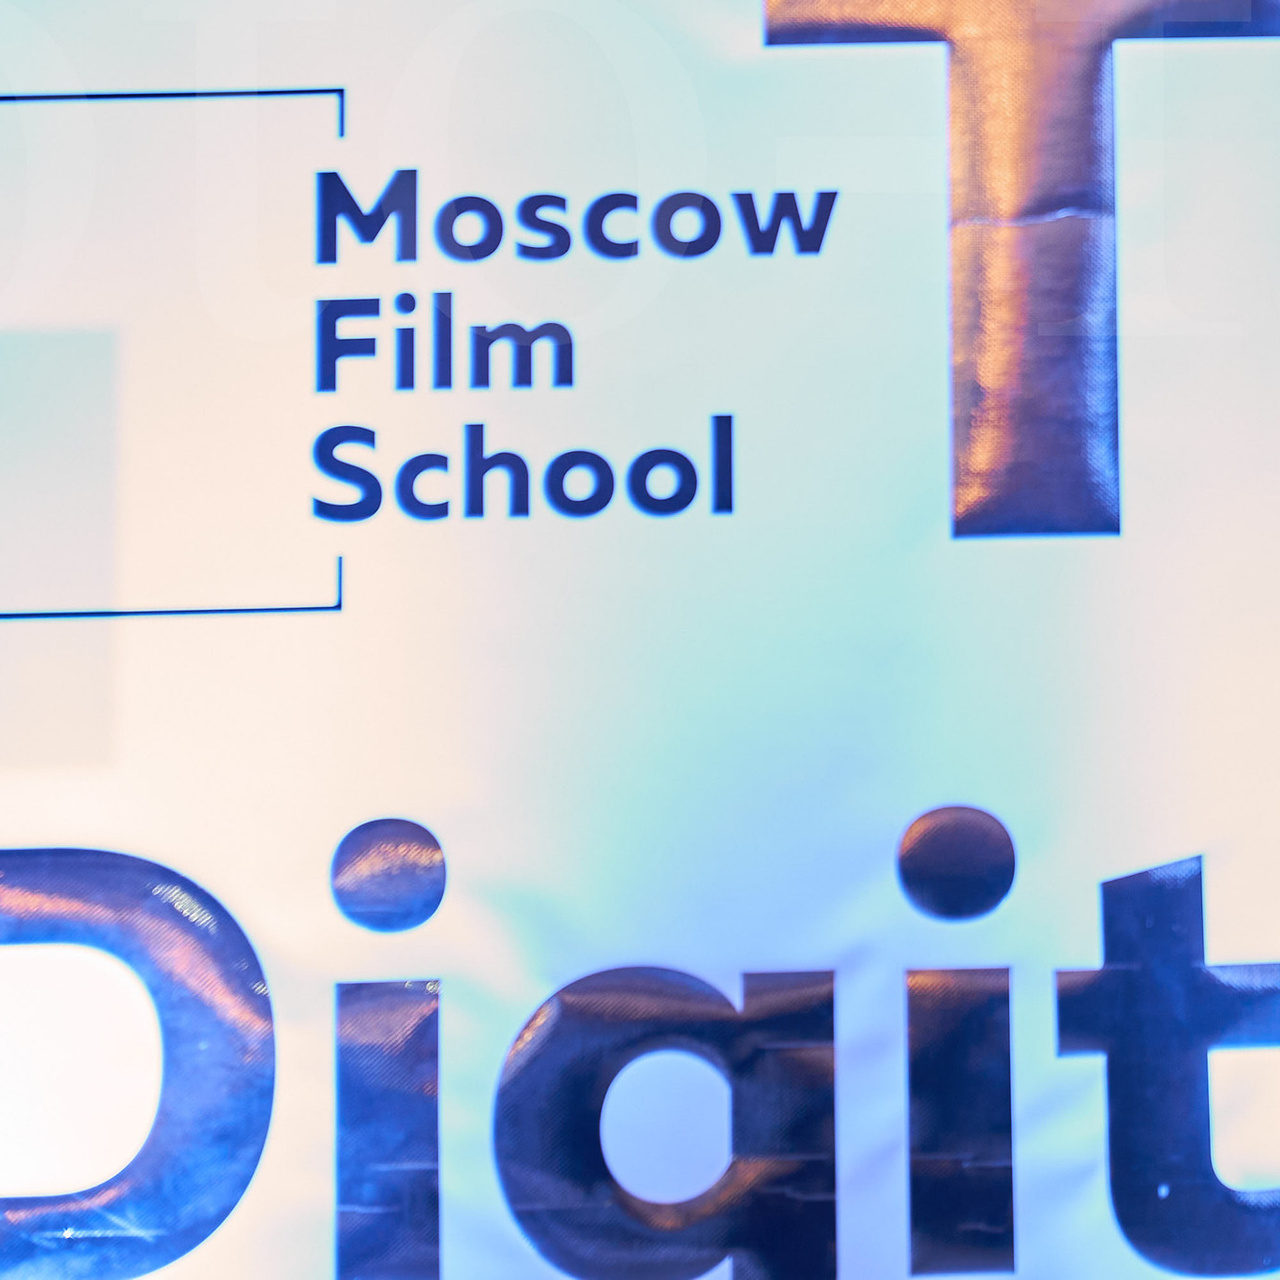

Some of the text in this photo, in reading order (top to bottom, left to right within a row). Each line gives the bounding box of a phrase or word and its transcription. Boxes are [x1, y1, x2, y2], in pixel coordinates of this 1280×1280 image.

[315, 168, 839, 264] Moscow
[315, 291, 575, 392] Film
[311, 414, 734, 523] School
